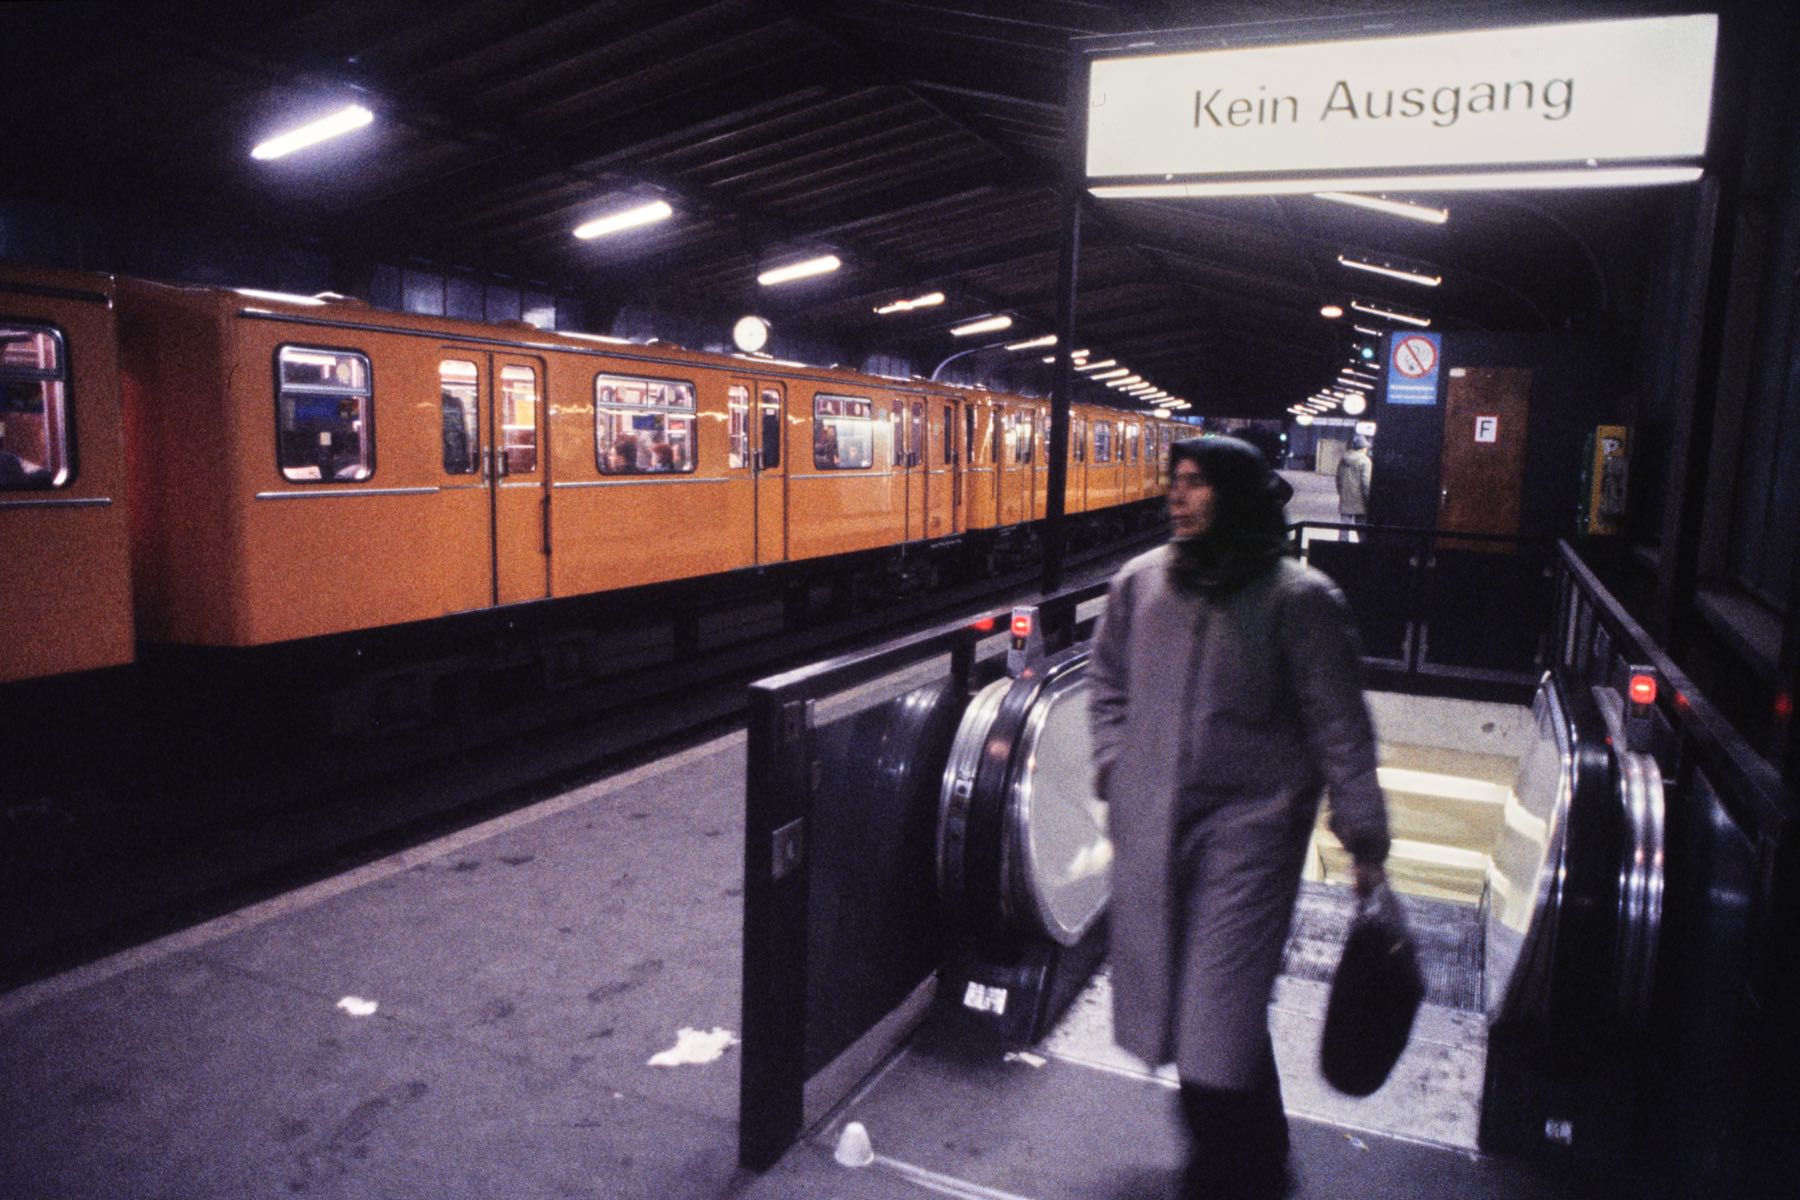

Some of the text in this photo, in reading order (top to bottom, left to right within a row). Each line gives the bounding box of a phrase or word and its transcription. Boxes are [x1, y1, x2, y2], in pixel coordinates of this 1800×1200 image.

[1193, 77, 1576, 129] Kein Ausgang
[1480, 420, 1493, 438] F
